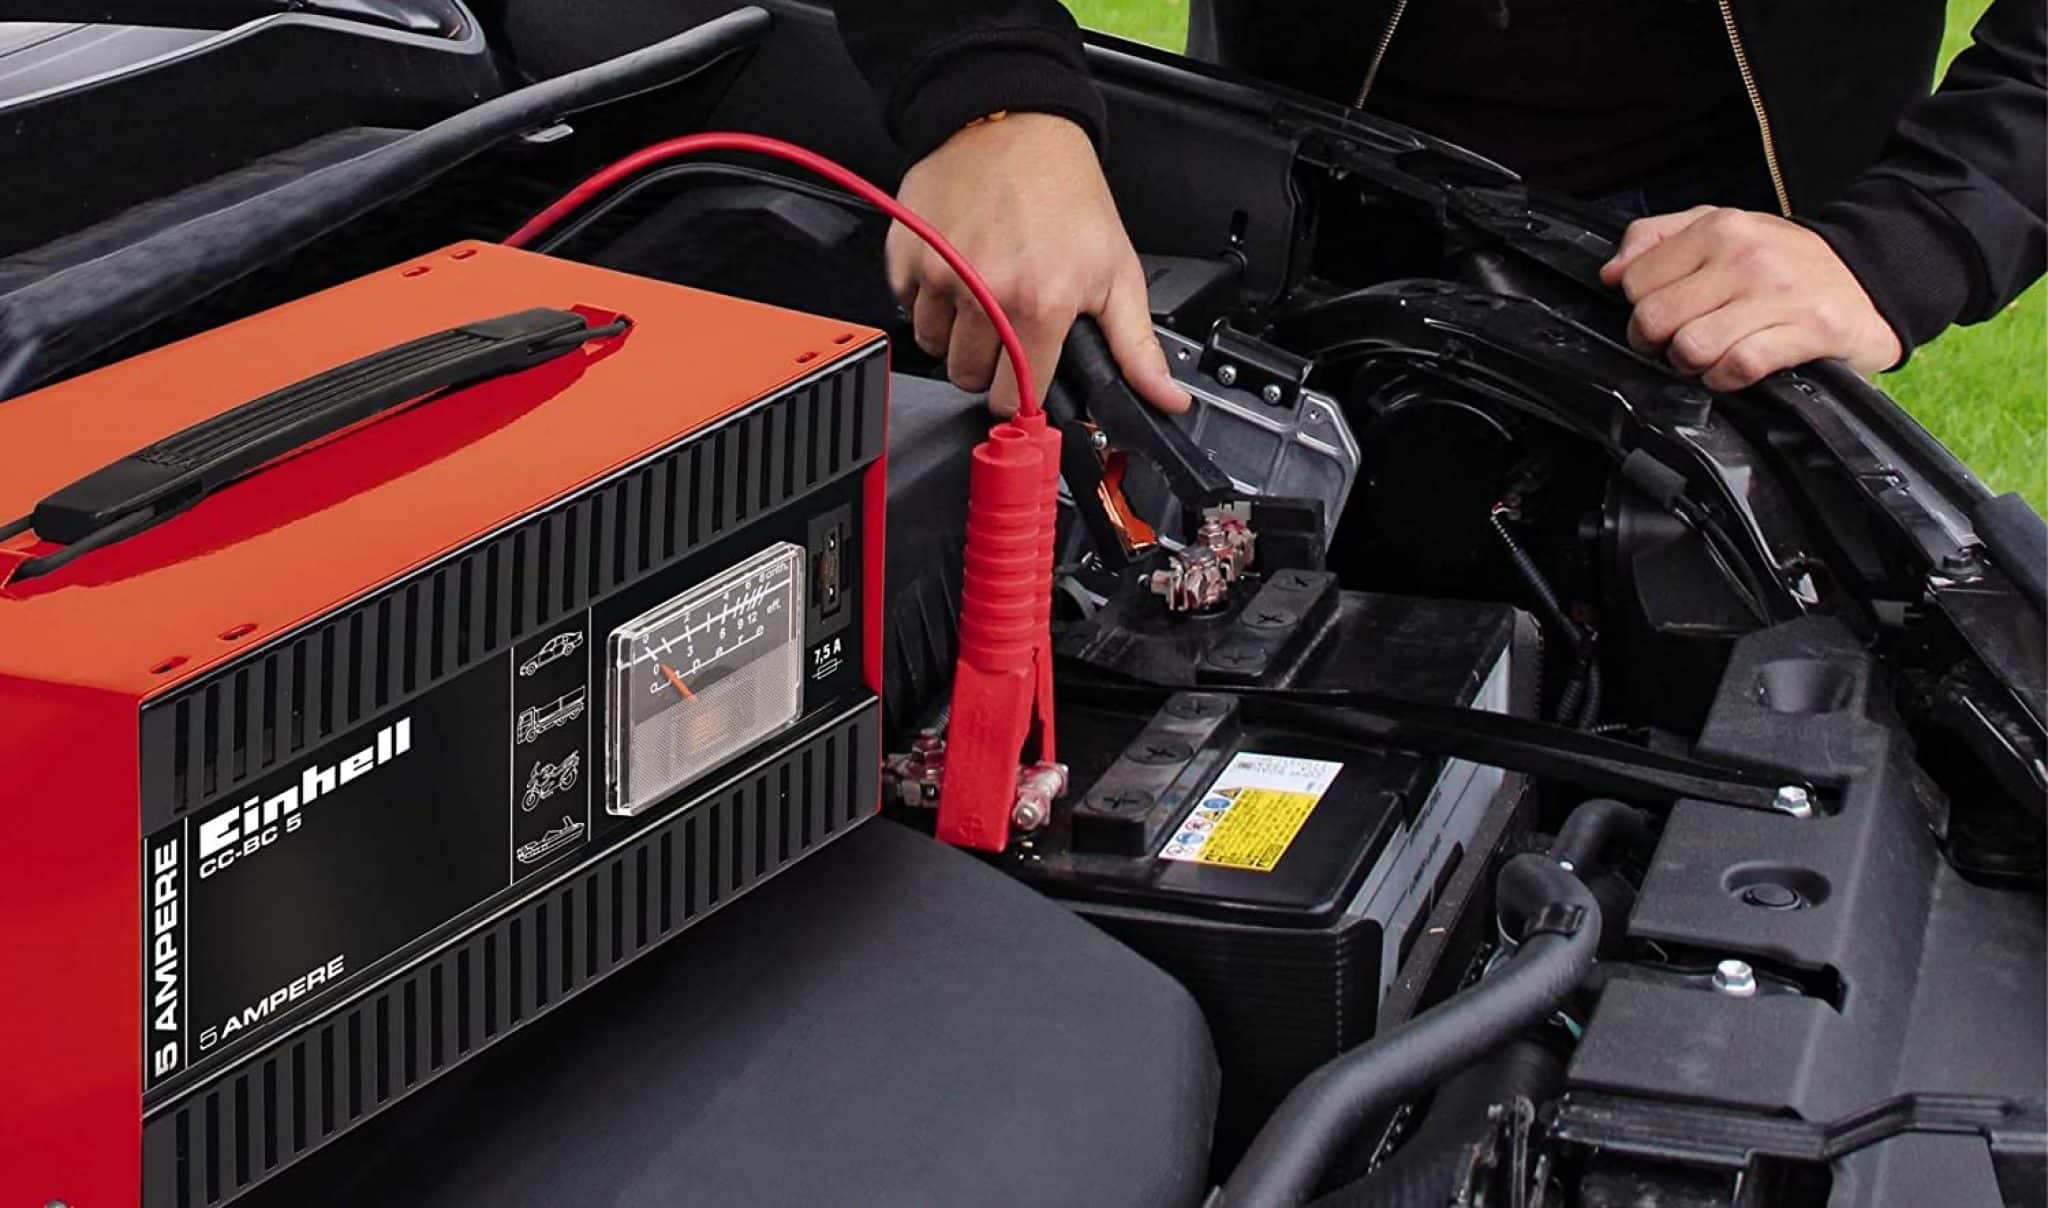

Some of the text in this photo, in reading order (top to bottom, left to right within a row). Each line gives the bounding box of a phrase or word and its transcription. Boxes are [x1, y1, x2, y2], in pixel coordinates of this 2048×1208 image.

[719, 627, 726, 639] 6
[737, 618, 744, 630] 9
[747, 610, 758, 624] 12
[814, 637, 841, 664] 7,5 A
[200, 717, 411, 859] Einhell
[200, 812, 302, 879] CC-BC 5
[155, 838, 178, 1078] 5 AMPERE
[200, 954, 345, 1051] 5 AMPERE
